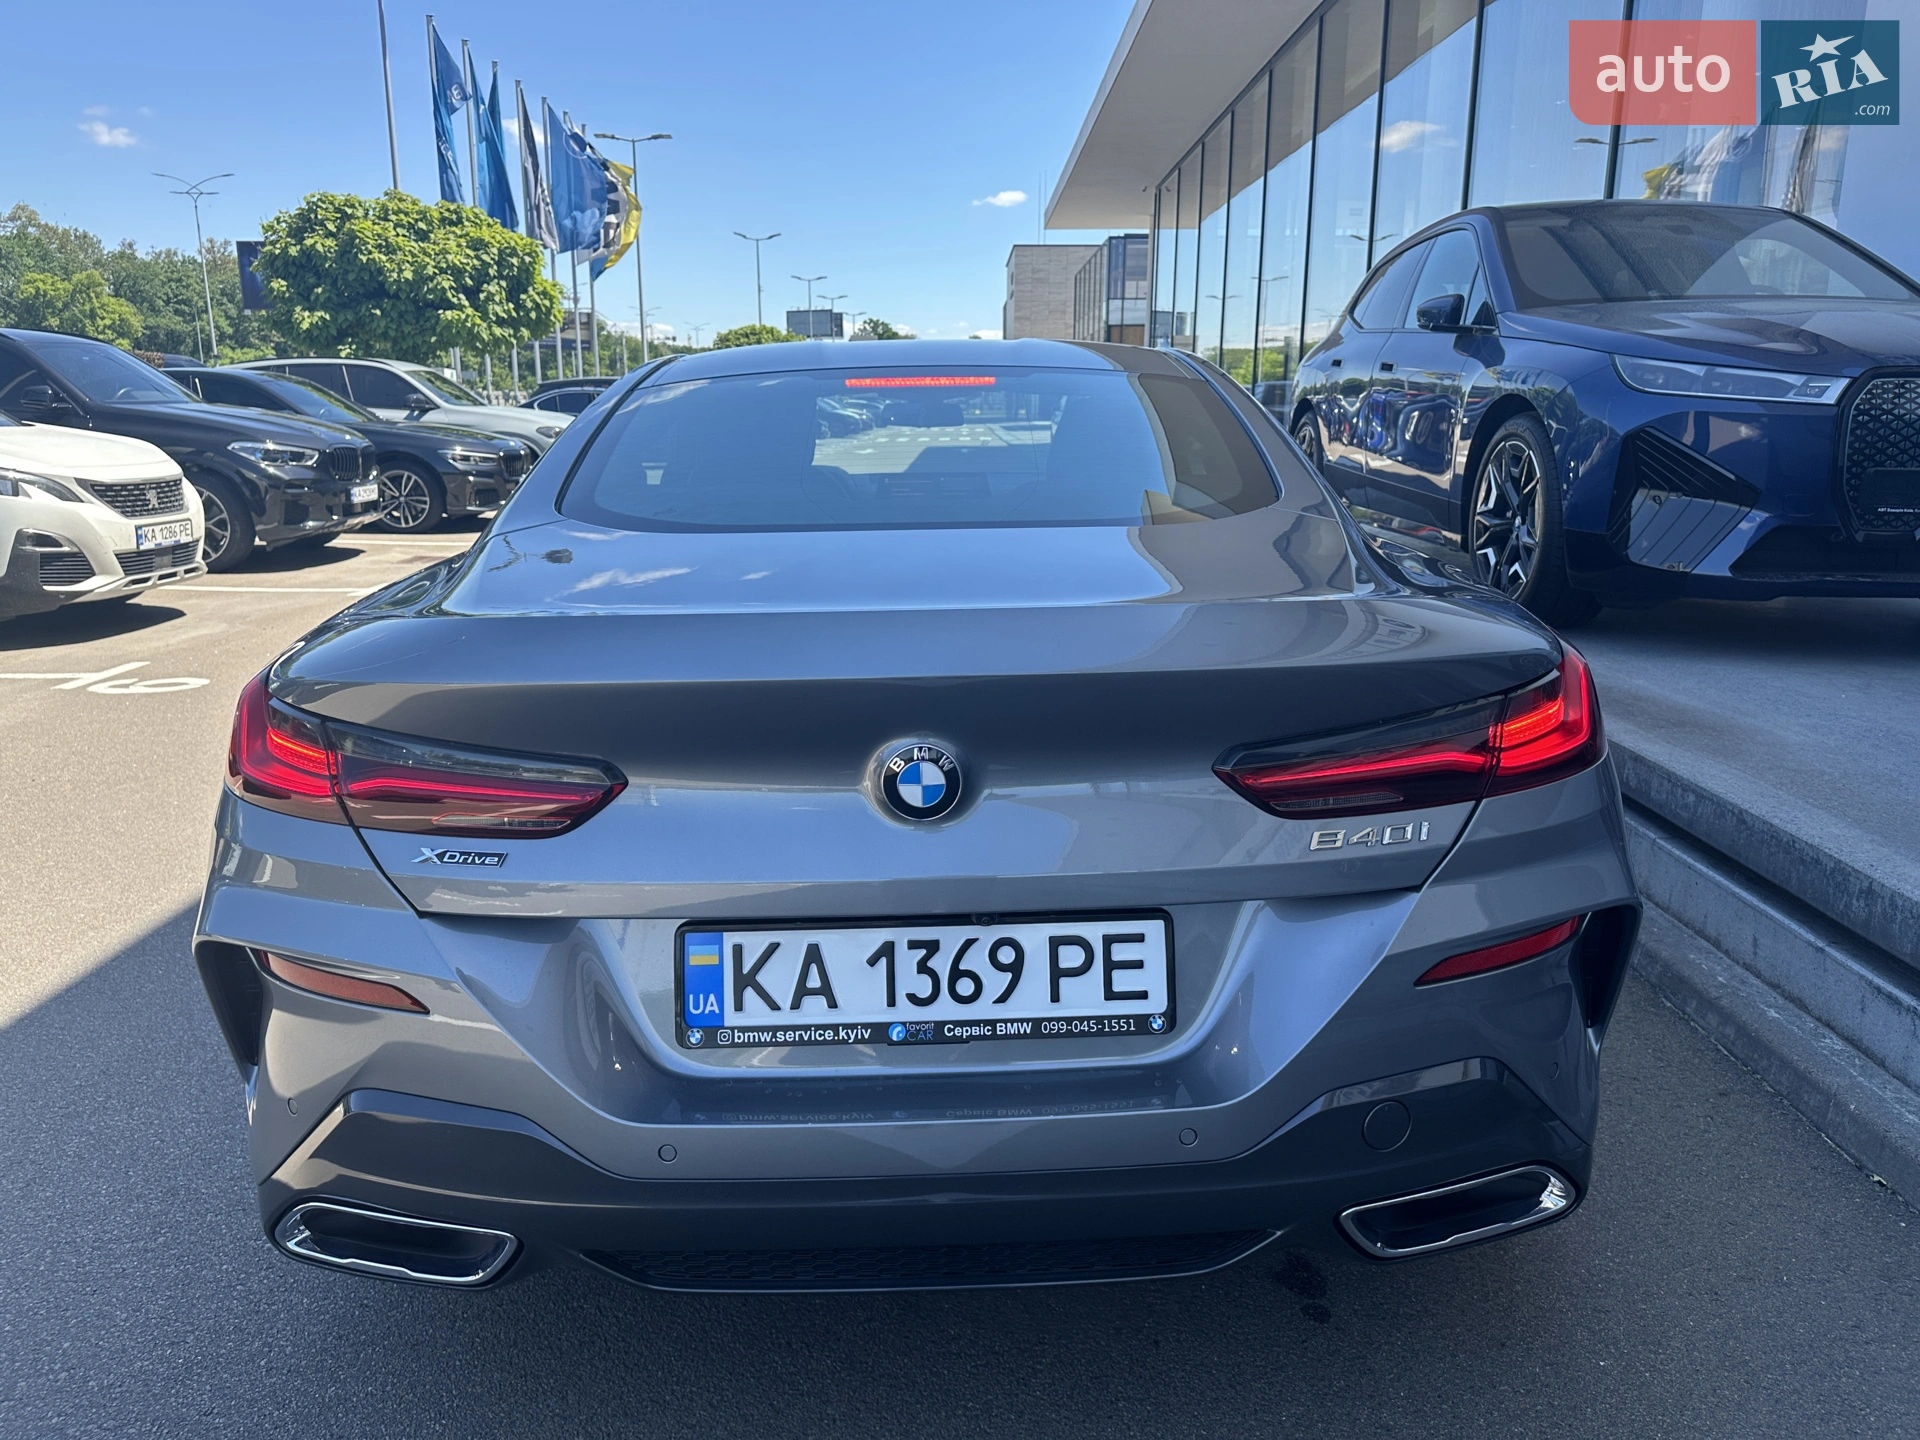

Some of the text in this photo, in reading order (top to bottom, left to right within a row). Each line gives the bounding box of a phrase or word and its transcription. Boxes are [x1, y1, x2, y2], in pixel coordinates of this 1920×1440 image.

[144, 522, 191, 543] KA 1286 PE
[889, 747, 955, 772] BMW
[1310, 821, 1430, 851] 840i
[732, 933, 1149, 1012] KA 1369 PE
[689, 993, 720, 1015] UA
[734, 1026, 871, 1044] bmw.service.kyiv
[906, 1022, 934, 1031] favorit
[906, 1030, 934, 1042] CAR
[944, 1019, 1136, 1038] Сервіс BMW 099-045-1551
